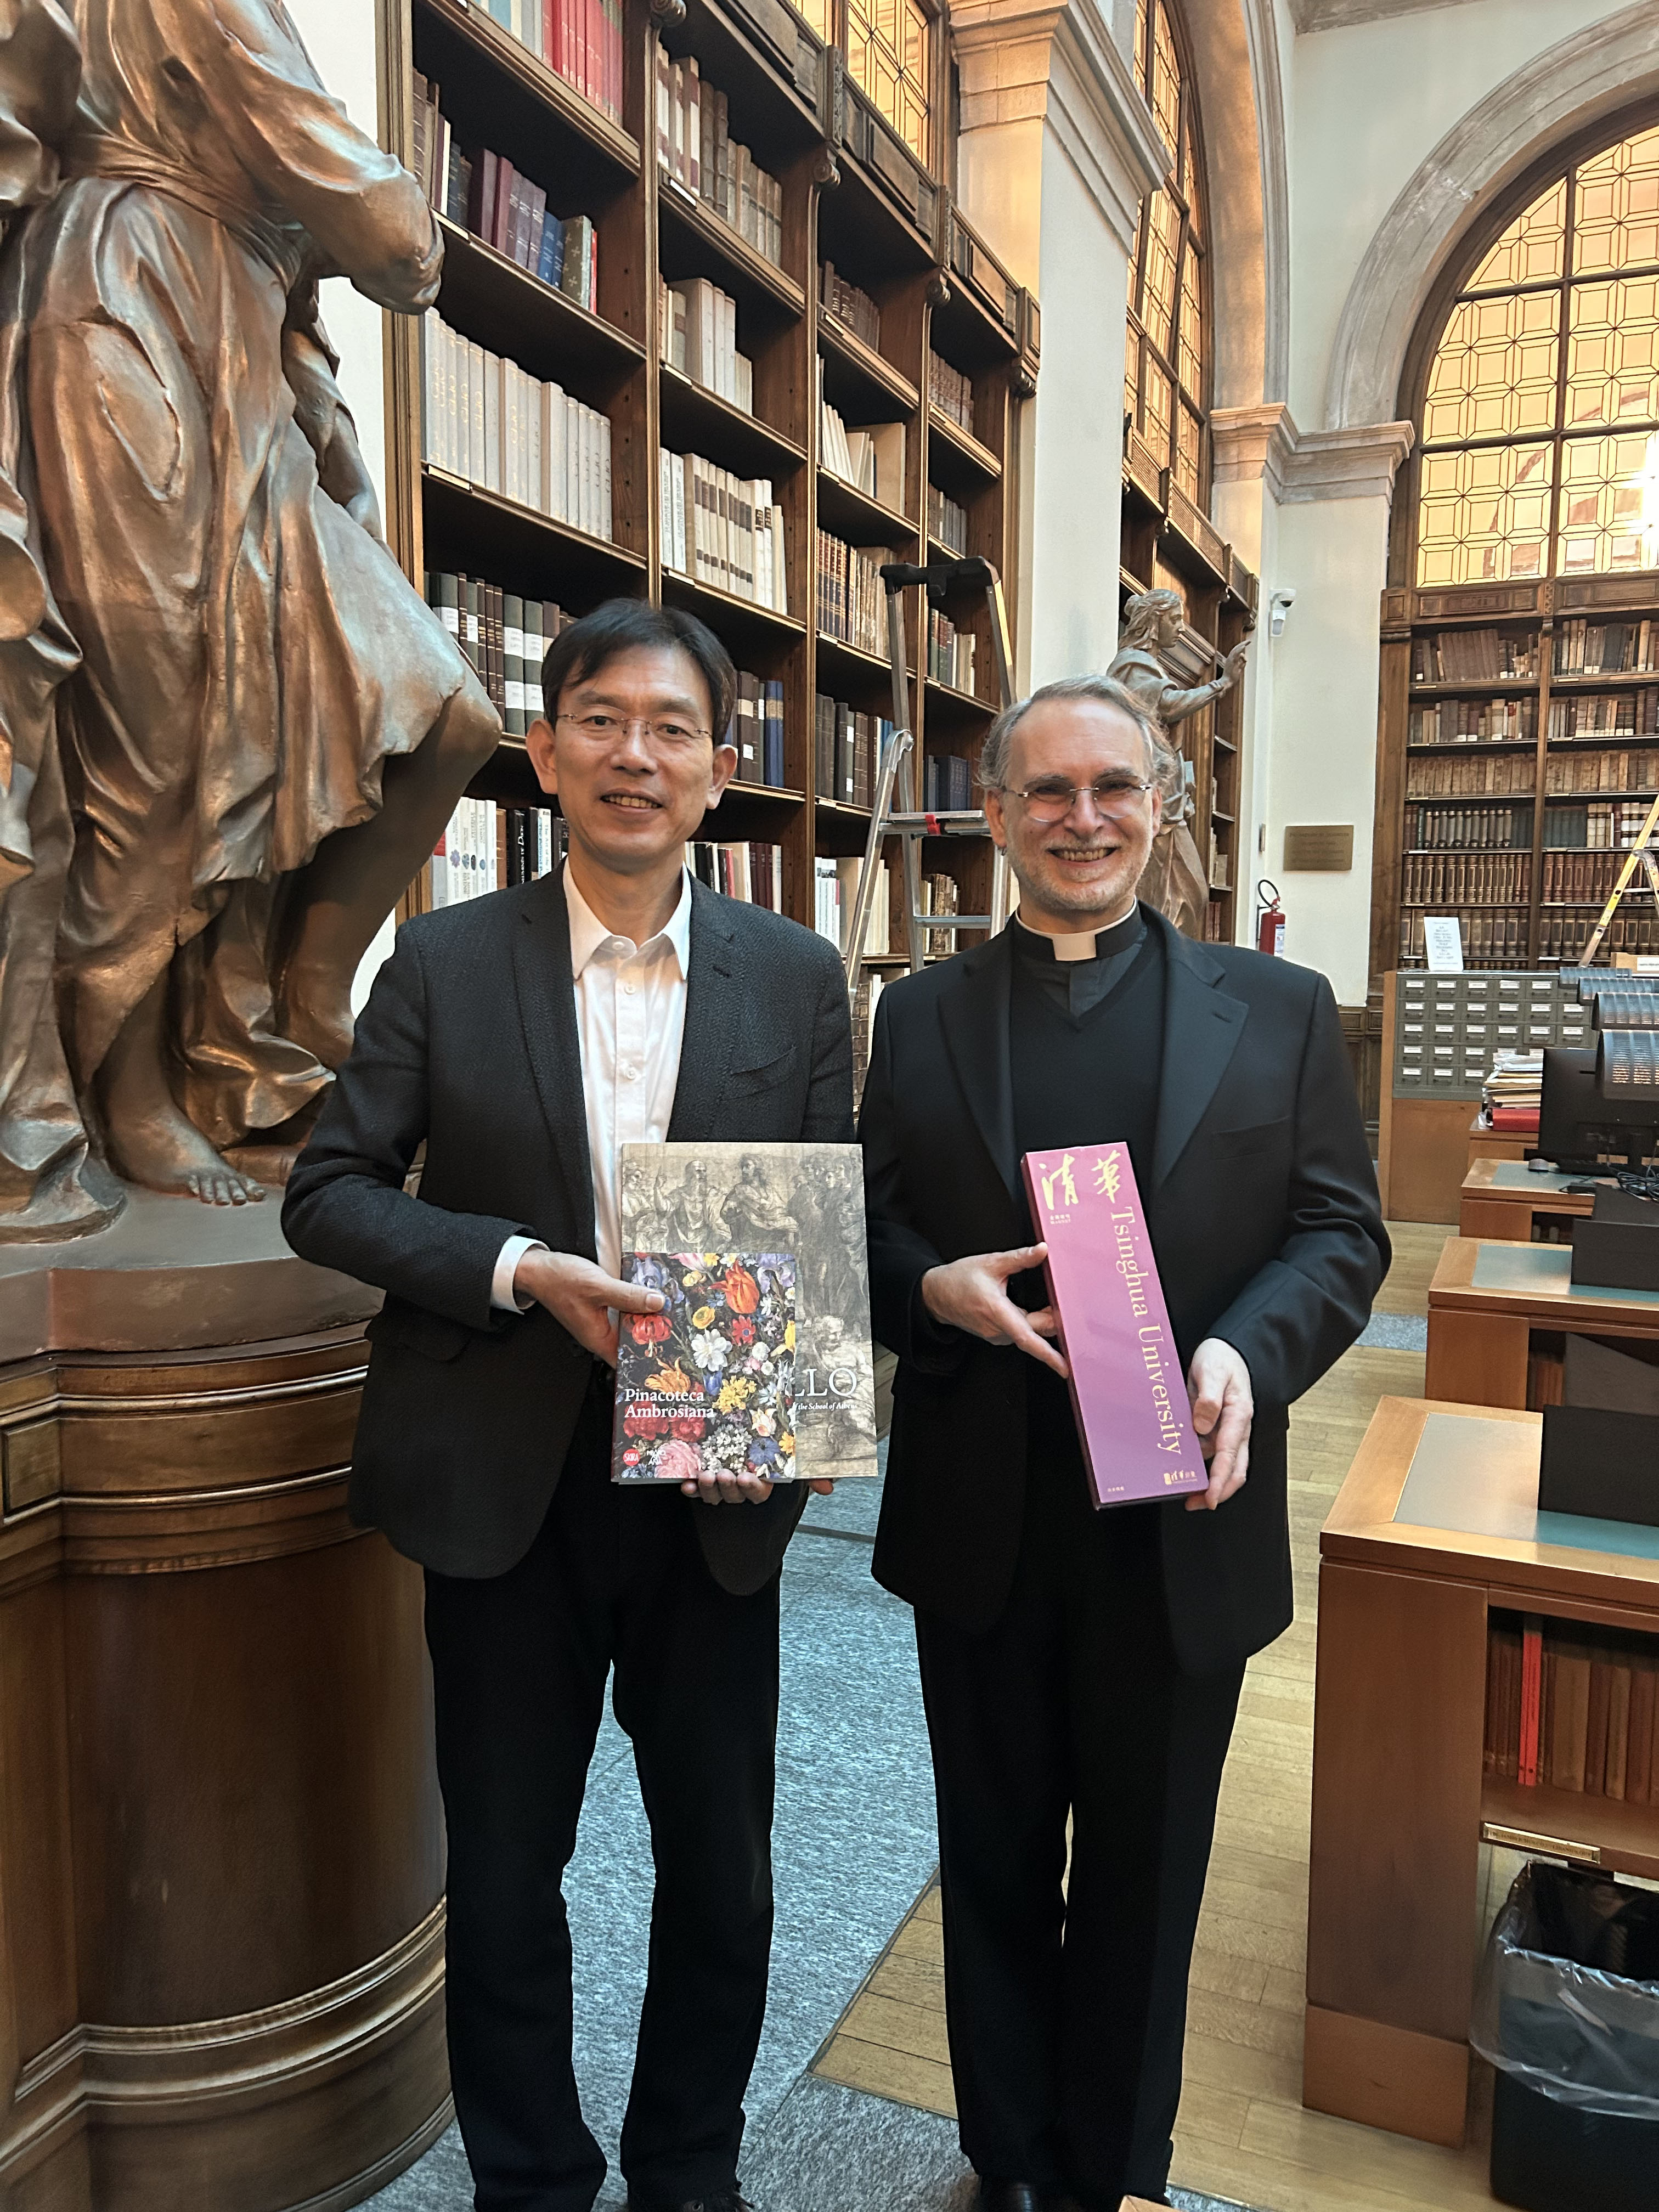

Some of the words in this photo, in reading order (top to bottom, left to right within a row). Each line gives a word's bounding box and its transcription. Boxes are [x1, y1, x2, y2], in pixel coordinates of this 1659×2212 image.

[1111, 1206, 1149, 1317] Tsinghua
[1138, 1323, 1184, 1455] University
[624, 1389, 705, 1402] Pinacoteca
[624, 1404, 715, 1418] Ambrosiana
[829, 1402, 836, 1412] of
[624, 1453, 640, 1462] SKIRA
